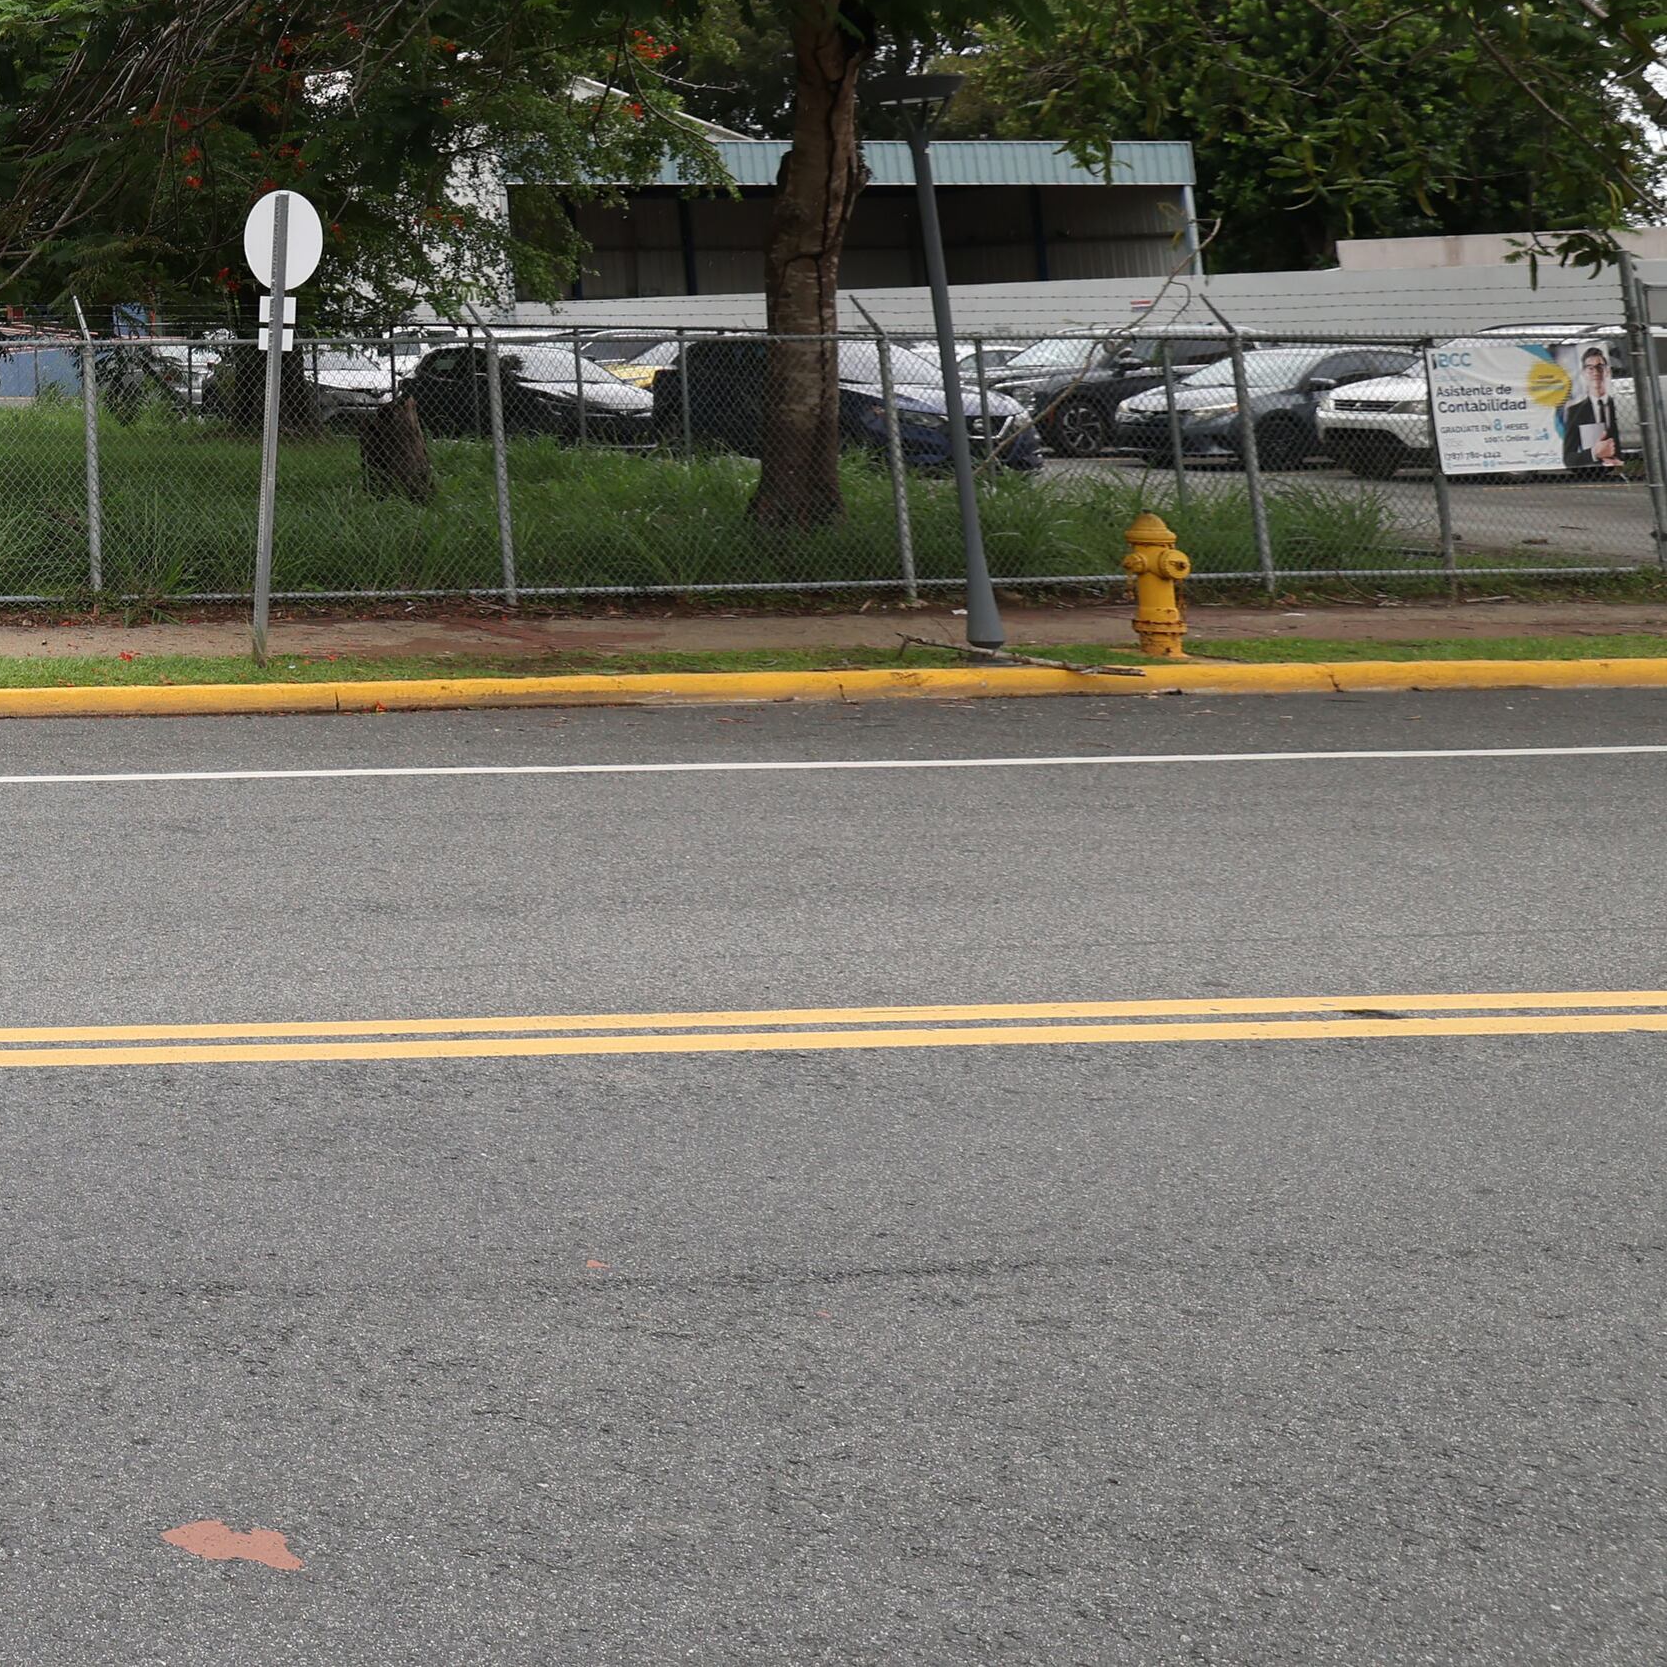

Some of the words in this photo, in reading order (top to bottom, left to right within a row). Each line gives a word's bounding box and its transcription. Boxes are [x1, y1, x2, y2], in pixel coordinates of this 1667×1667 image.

[1436, 385, 1493, 397] Asistente
[1496, 384, 1512, 395] de
[1438, 398, 1527, 413] Contabilidad
[1493, 418, 1503, 431] 8
